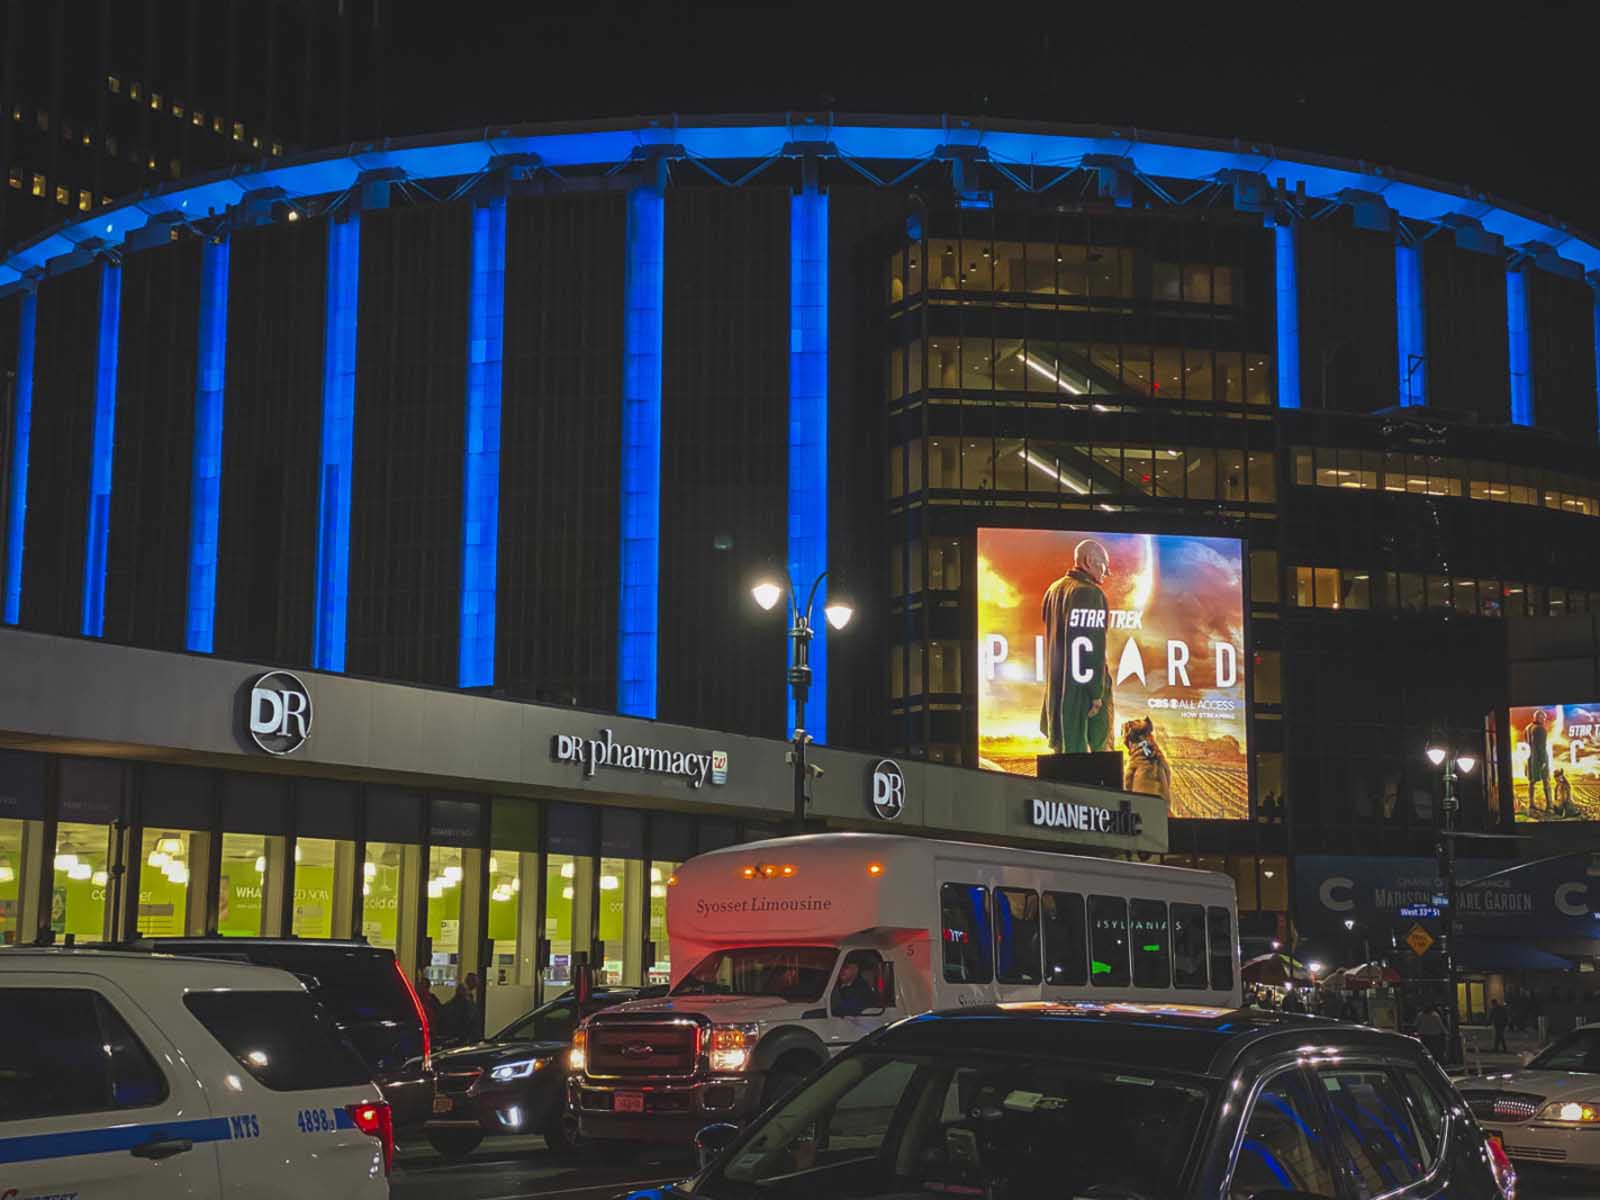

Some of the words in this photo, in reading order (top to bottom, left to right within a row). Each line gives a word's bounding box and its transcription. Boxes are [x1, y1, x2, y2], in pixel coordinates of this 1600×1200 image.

[1070, 609, 1105, 628] STAR
[1109, 610, 1143, 630] TREK
[250, 687, 311, 738] DR
[1179, 699, 1196, 709] ALL
[1199, 700, 1235, 710] ACCESS
[558, 735, 585, 762] DR
[589, 728, 712, 788] pharmacy
[873, 772, 903, 808] DR
[696, 899, 748, 918] Syosset
[751, 896, 832, 912] Limousine
[1400, 907, 1419, 917] West
[1485, 890, 1533, 912] GARDEN
[906, 943, 915, 957] 5
[231, 1114, 260, 1139] MTS
